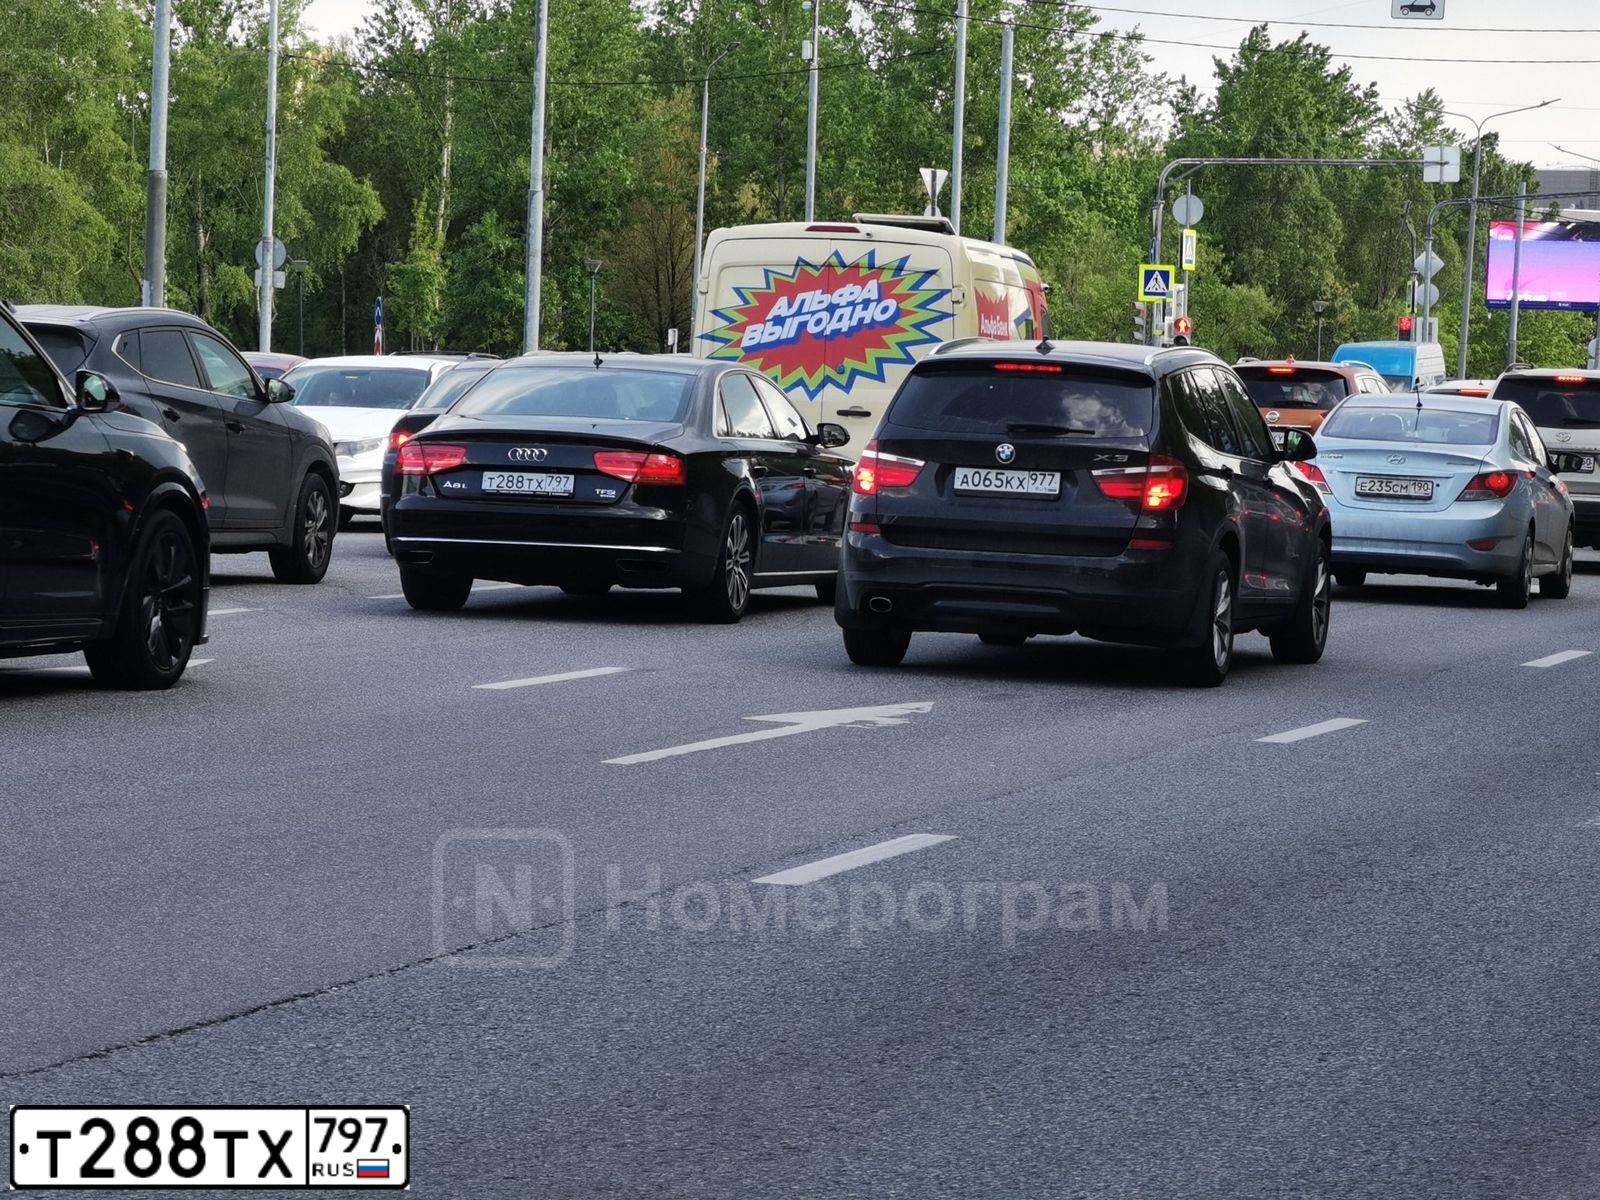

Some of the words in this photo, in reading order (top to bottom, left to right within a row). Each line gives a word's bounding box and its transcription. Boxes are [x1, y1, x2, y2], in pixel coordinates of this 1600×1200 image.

[765, 279, 879, 320] АЛЬФА
[740, 298, 898, 348] ВЫГОДНО
[1093, 453, 1128, 463] X3
[547, 475, 570, 488] 797
[1029, 472, 1056, 487] 977
